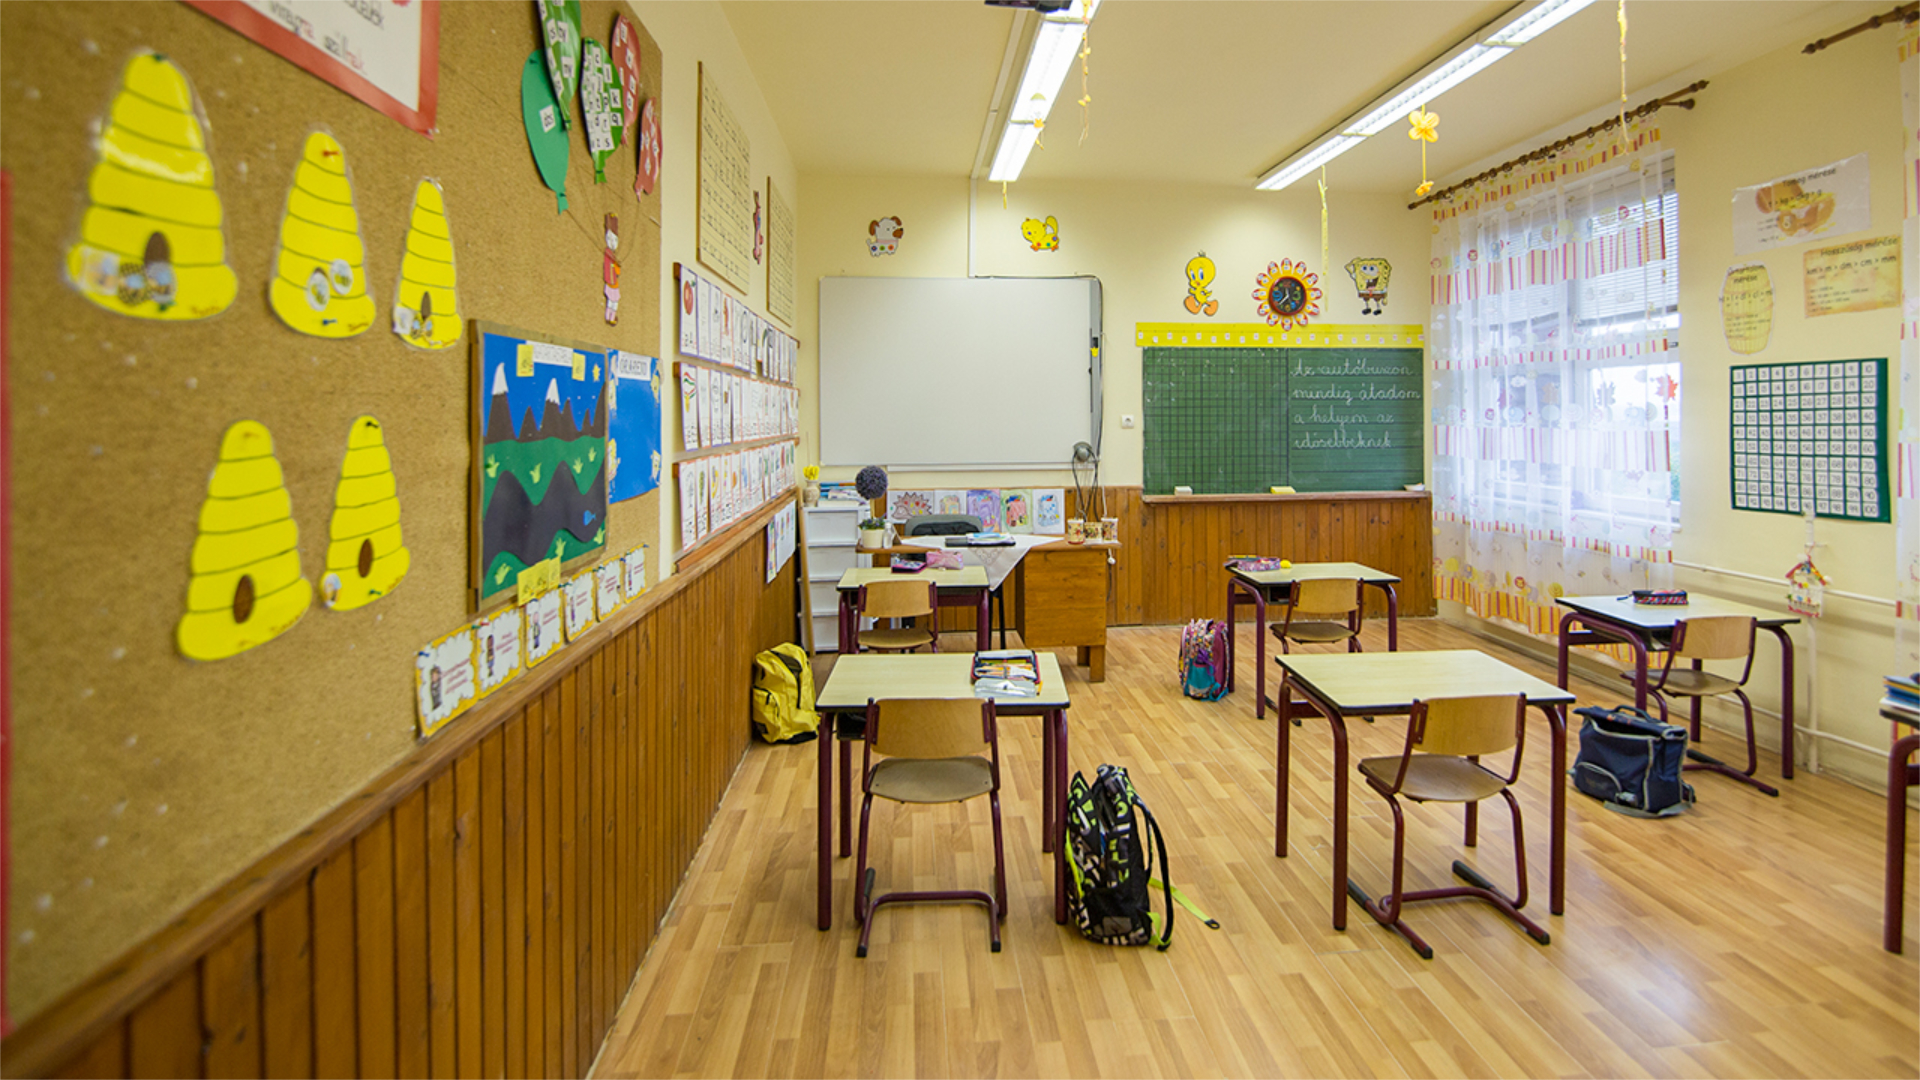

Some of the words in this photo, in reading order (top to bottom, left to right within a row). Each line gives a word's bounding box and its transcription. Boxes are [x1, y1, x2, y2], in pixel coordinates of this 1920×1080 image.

[1292, 383, 1353, 405] mindig
[1358, 383, 1420, 399] átadom
[1294, 414, 1304, 424] a
